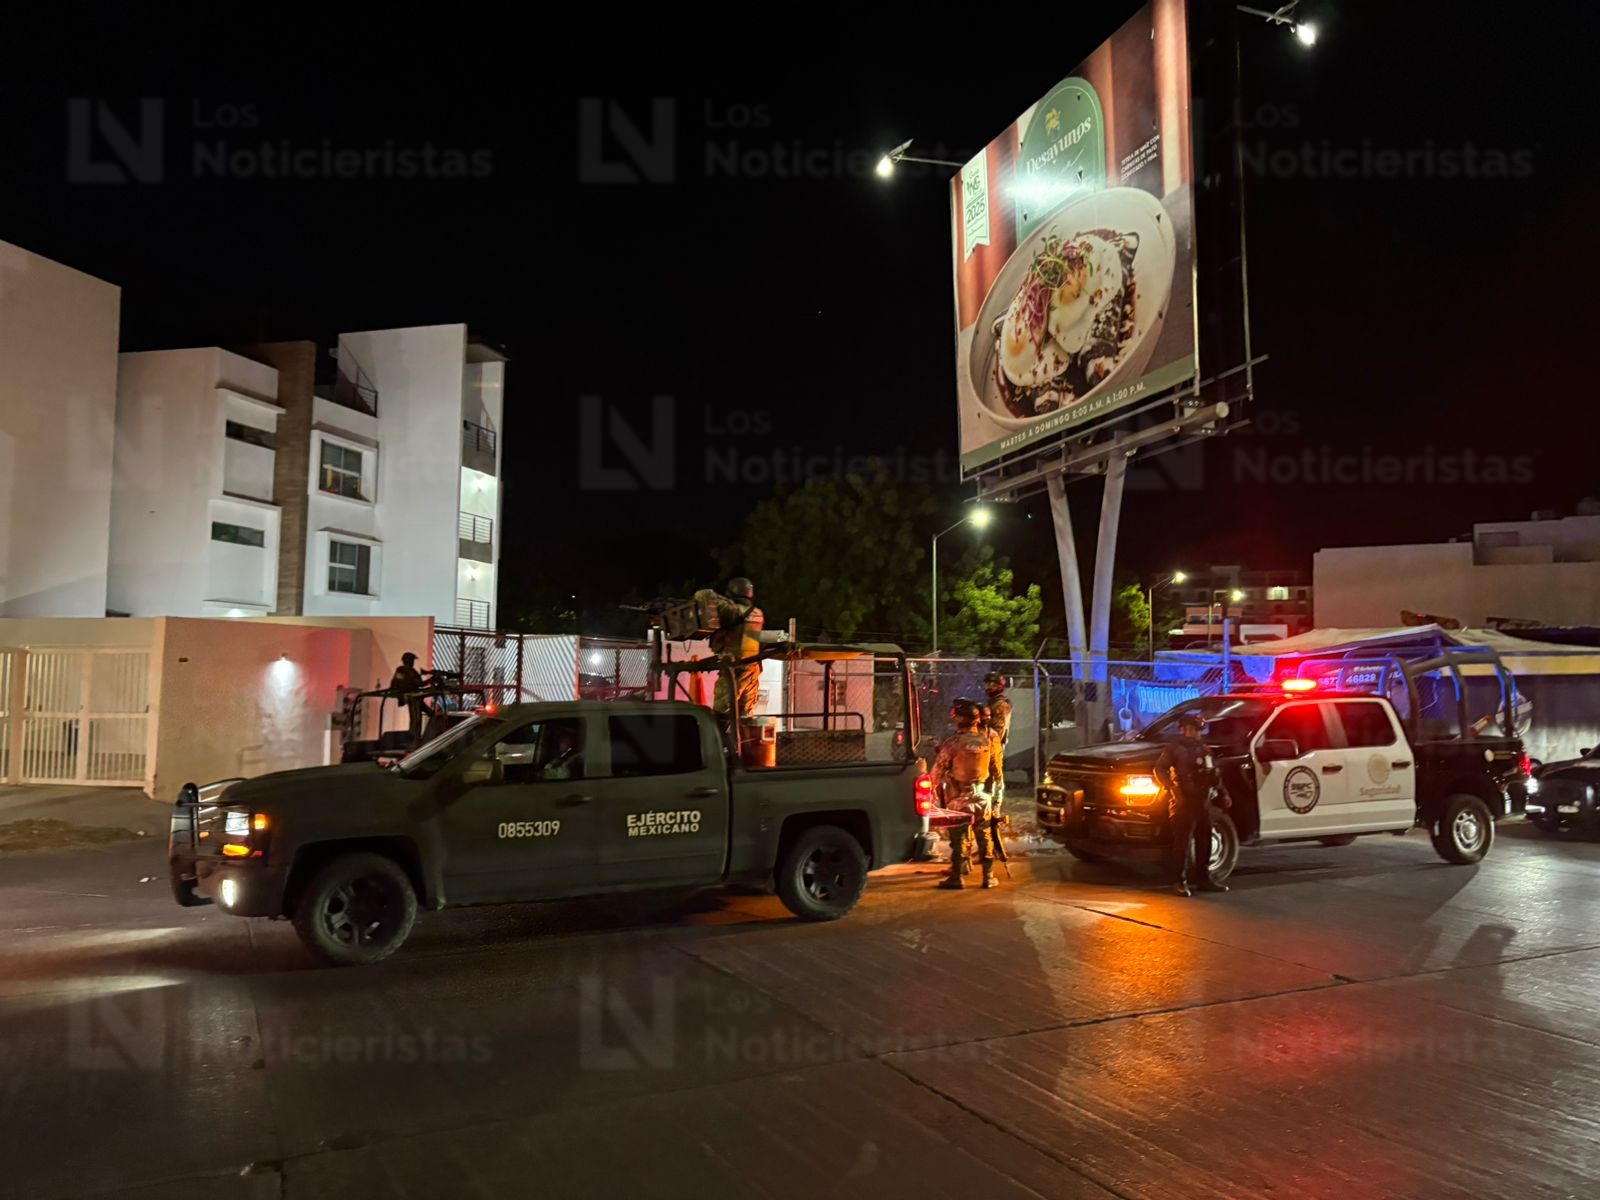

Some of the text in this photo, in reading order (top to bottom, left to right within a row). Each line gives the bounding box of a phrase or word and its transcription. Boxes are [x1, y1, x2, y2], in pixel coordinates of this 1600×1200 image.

[1026, 117, 1091, 175] Desayunos
[966, 197, 985, 225] 2025
[1000, 431, 1026, 450] MARTES
[1028, 428, 1034, 437] A
[1034, 413, 1070, 435] DOMINGO
[1106, 395, 1111, 406] A
[497, 820, 561, 839] 0855309
[626, 810, 701, 827] EJÉRCITO
[628, 824, 700, 837] MEXICANO
